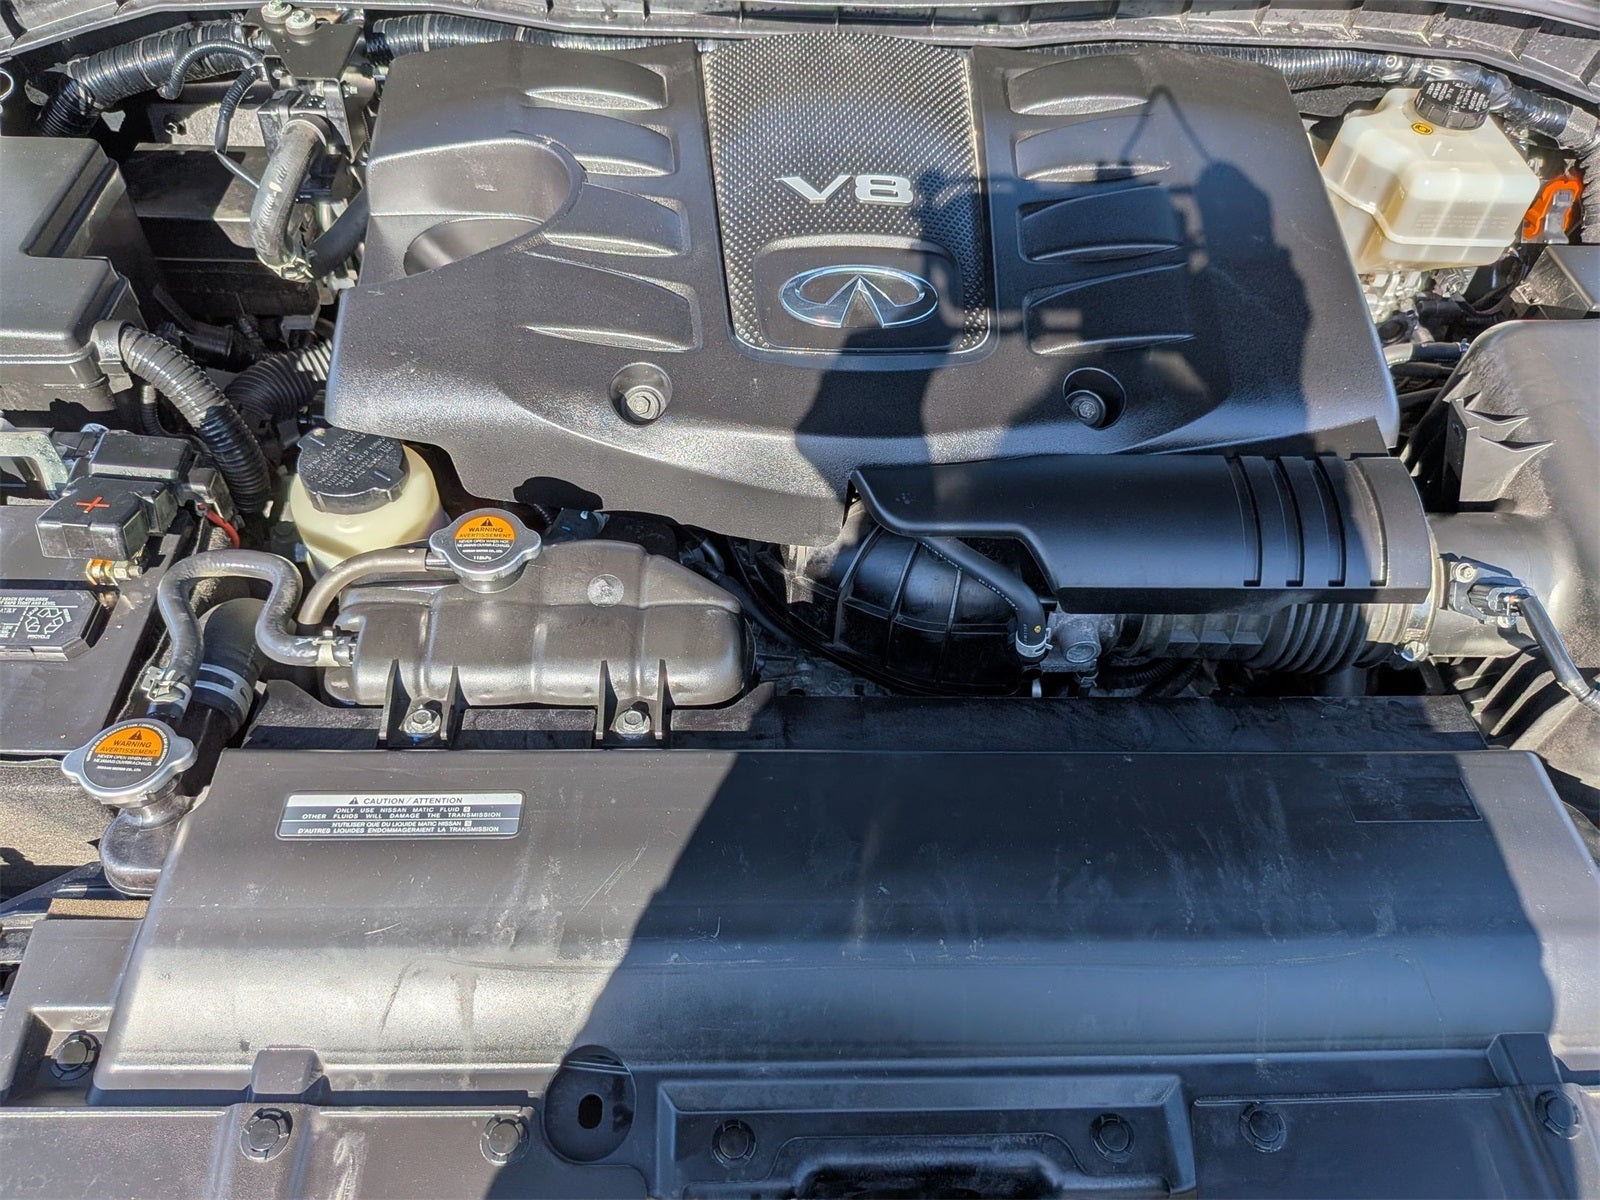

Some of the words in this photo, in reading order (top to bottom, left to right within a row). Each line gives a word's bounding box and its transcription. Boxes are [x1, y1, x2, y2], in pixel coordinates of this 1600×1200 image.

[774, 175, 913, 206] V8
[114, 740, 152, 748] WARNING
[100, 746, 158, 755] AVERTISSEMENT
